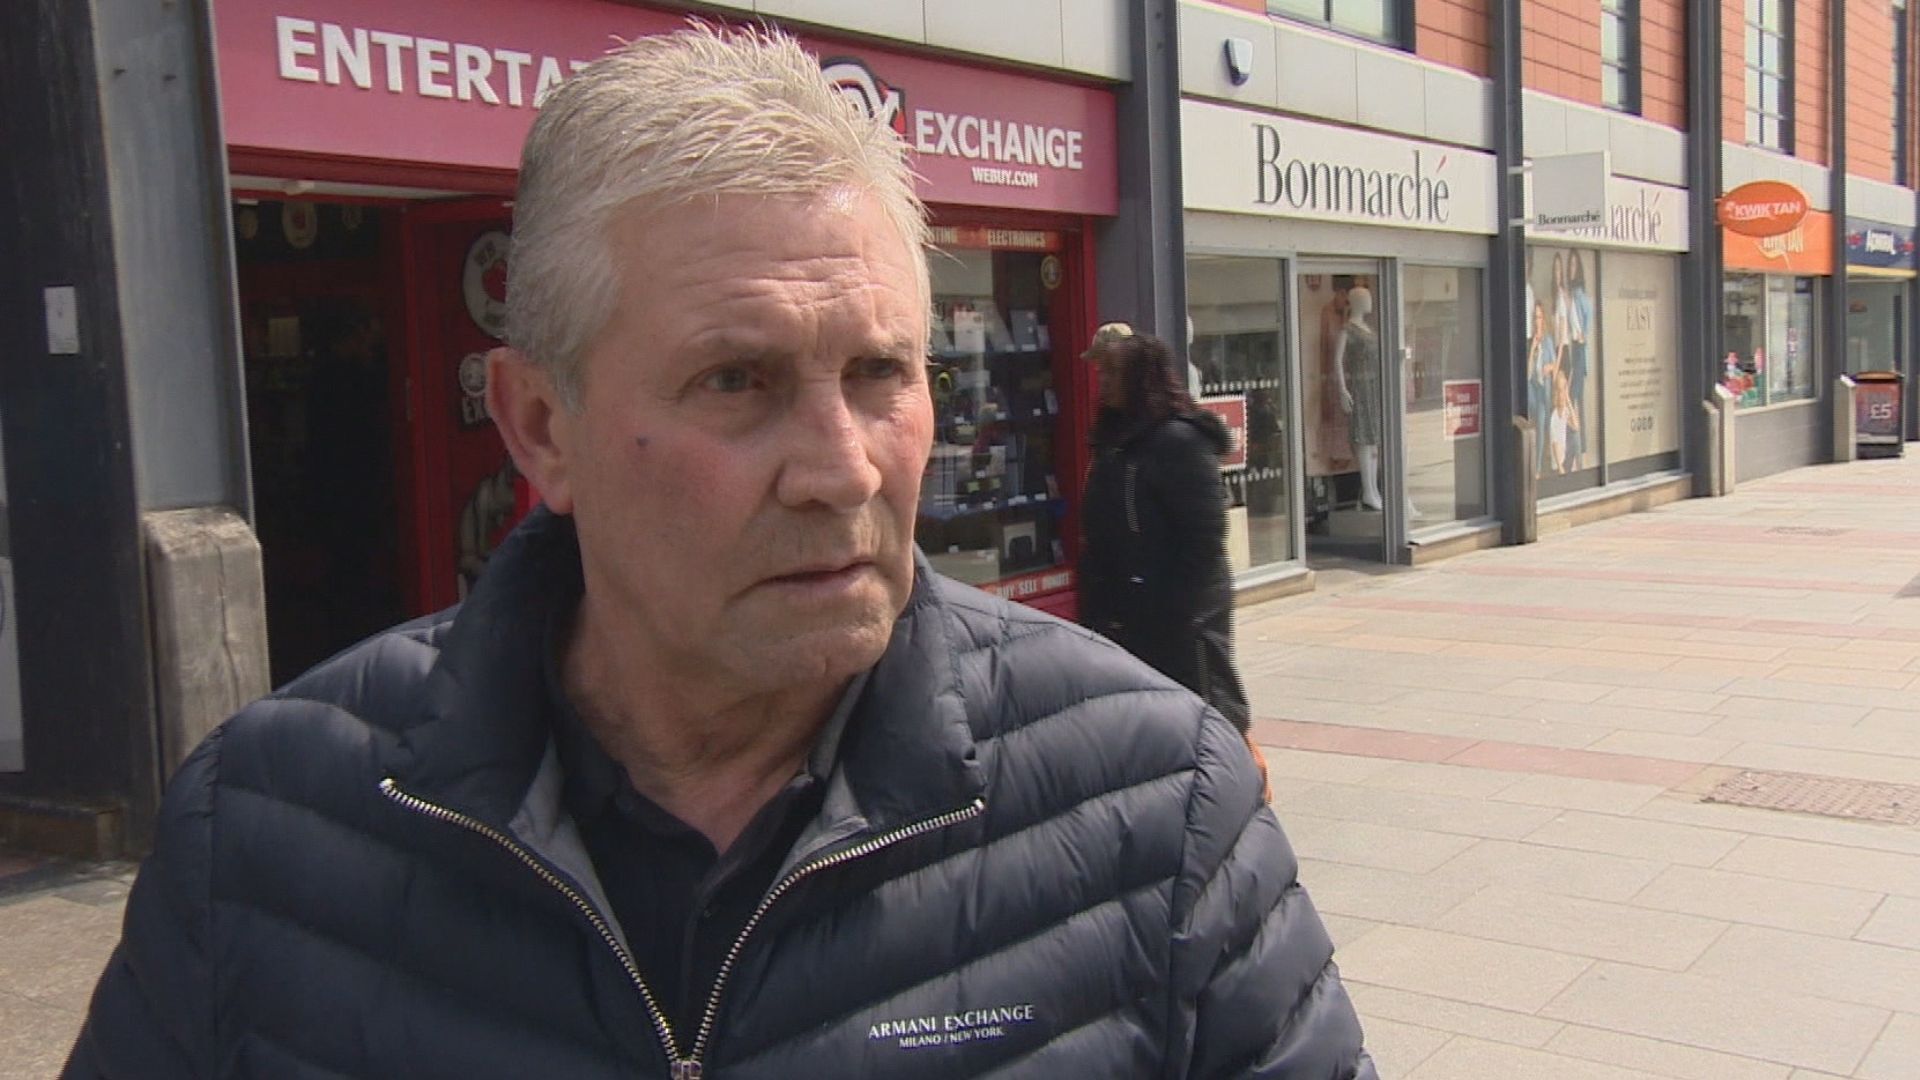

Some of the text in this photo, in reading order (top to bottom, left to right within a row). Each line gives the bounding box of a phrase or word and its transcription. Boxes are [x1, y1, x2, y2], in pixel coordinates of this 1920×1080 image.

[277, 15, 592, 108] ENTERTA
[915, 109, 1083, 170] EXCHANGE
[971, 166, 1039, 188] WEBUY.COM
[1252, 122, 1450, 223] Bonmarché
[1537, 209, 1601, 226] Bonmarché
[1735, 200, 1801, 219] KWIK TAN
[987, 228, 1046, 248] ELECTRONICS
[1626, 304, 1653, 331] EASY
[1870, 403, 1892, 420] £5
[868, 1004, 1035, 1040] ARMANI EXCHANGE
[898, 1033, 941, 1049] MILANO
[949, 1030, 972, 1044] NEW
[974, 1026, 1005, 1040] YORK
